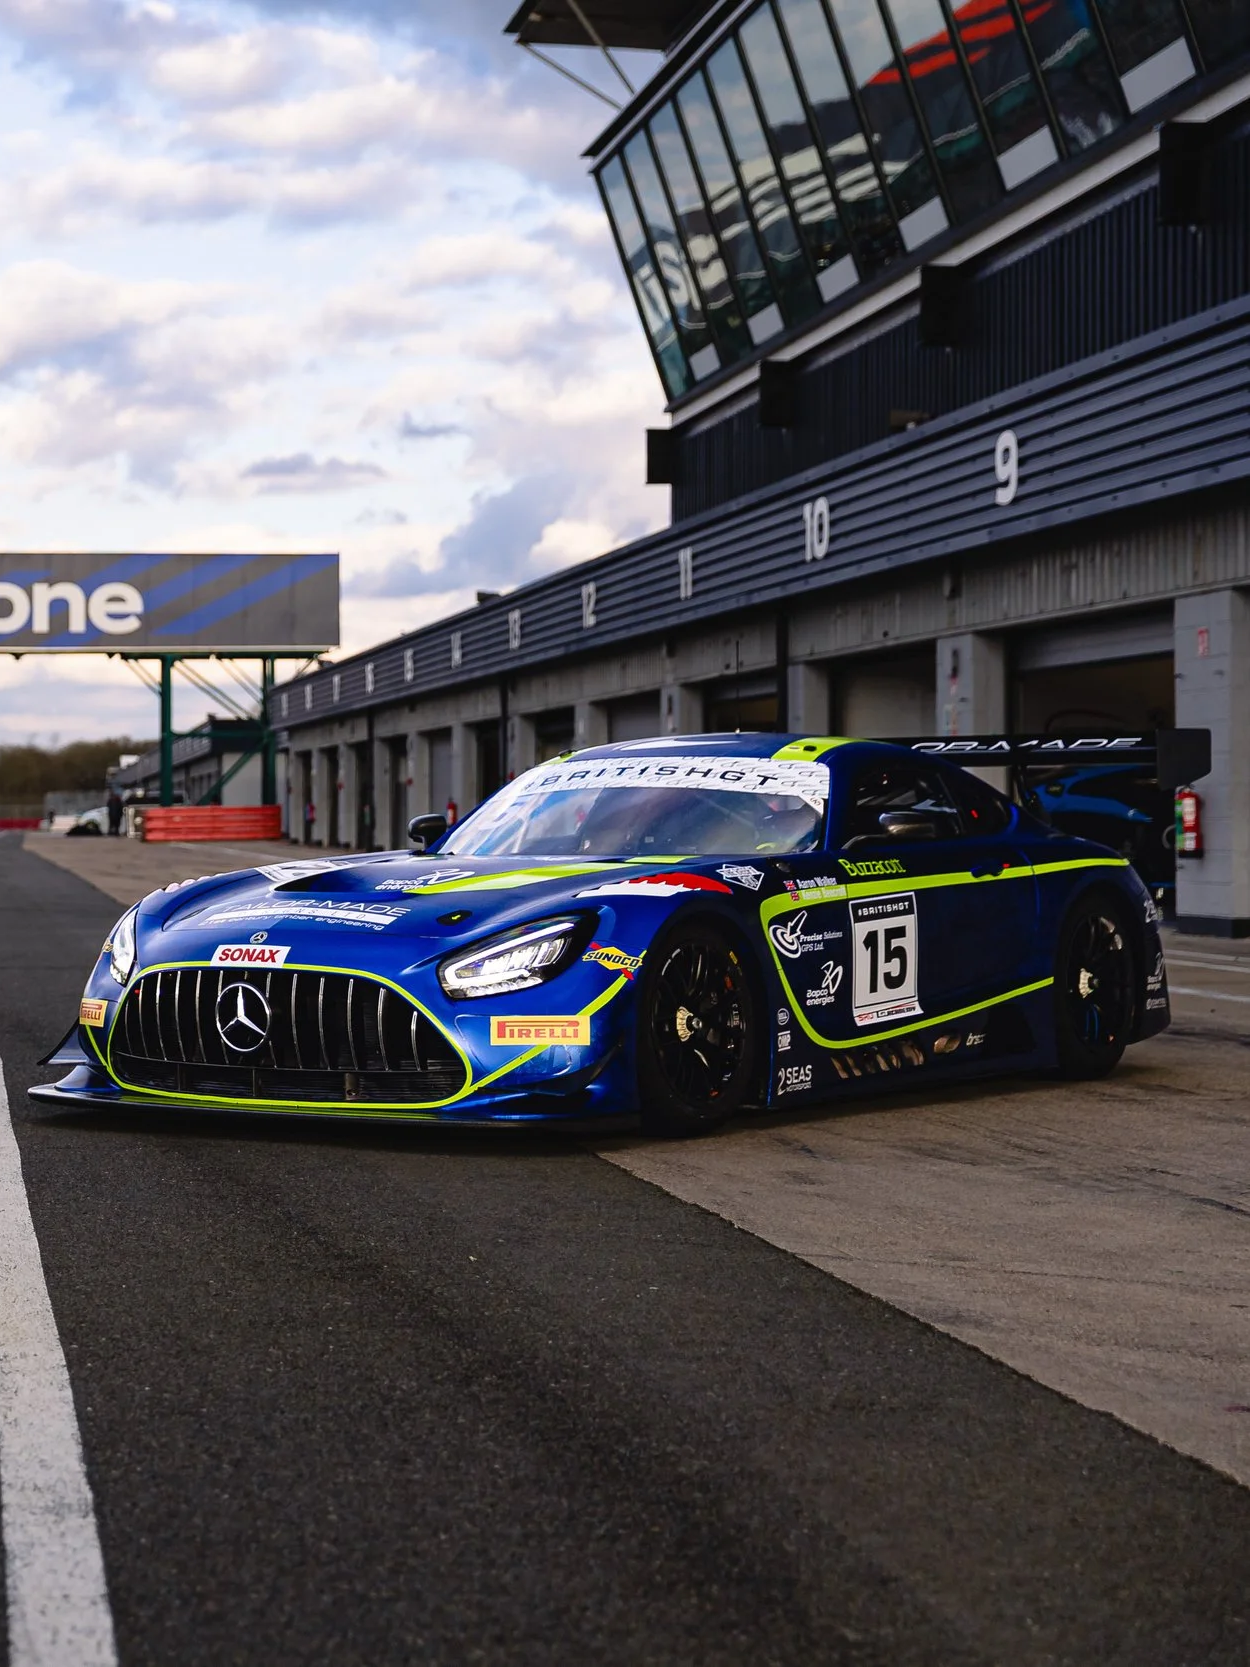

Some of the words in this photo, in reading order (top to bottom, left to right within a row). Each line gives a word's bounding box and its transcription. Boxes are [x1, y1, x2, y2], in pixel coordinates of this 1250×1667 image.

[994, 429, 1019, 506] 9
[803, 496, 830, 563] 10
[678, 546, 693, 600] 11
[581, 581, 597, 628] 12
[525, 765, 779, 791] #BRITISHGT
[375, 884, 424, 892] energie
[223, 898, 411, 917] TAILOR-MADE
[857, 901, 910, 916] #BRITISHGT
[799, 933, 823, 942] Precise
[218, 948, 281, 963] SONAX
[584, 951, 641, 969] SUNOCO
[862, 925, 908, 994] 15
[806, 988, 829, 998] Bapco
[806, 995, 835, 1006] energies
[497, 1020, 580, 1039] PIRELLI
[786, 1064, 813, 1085] SEAS
